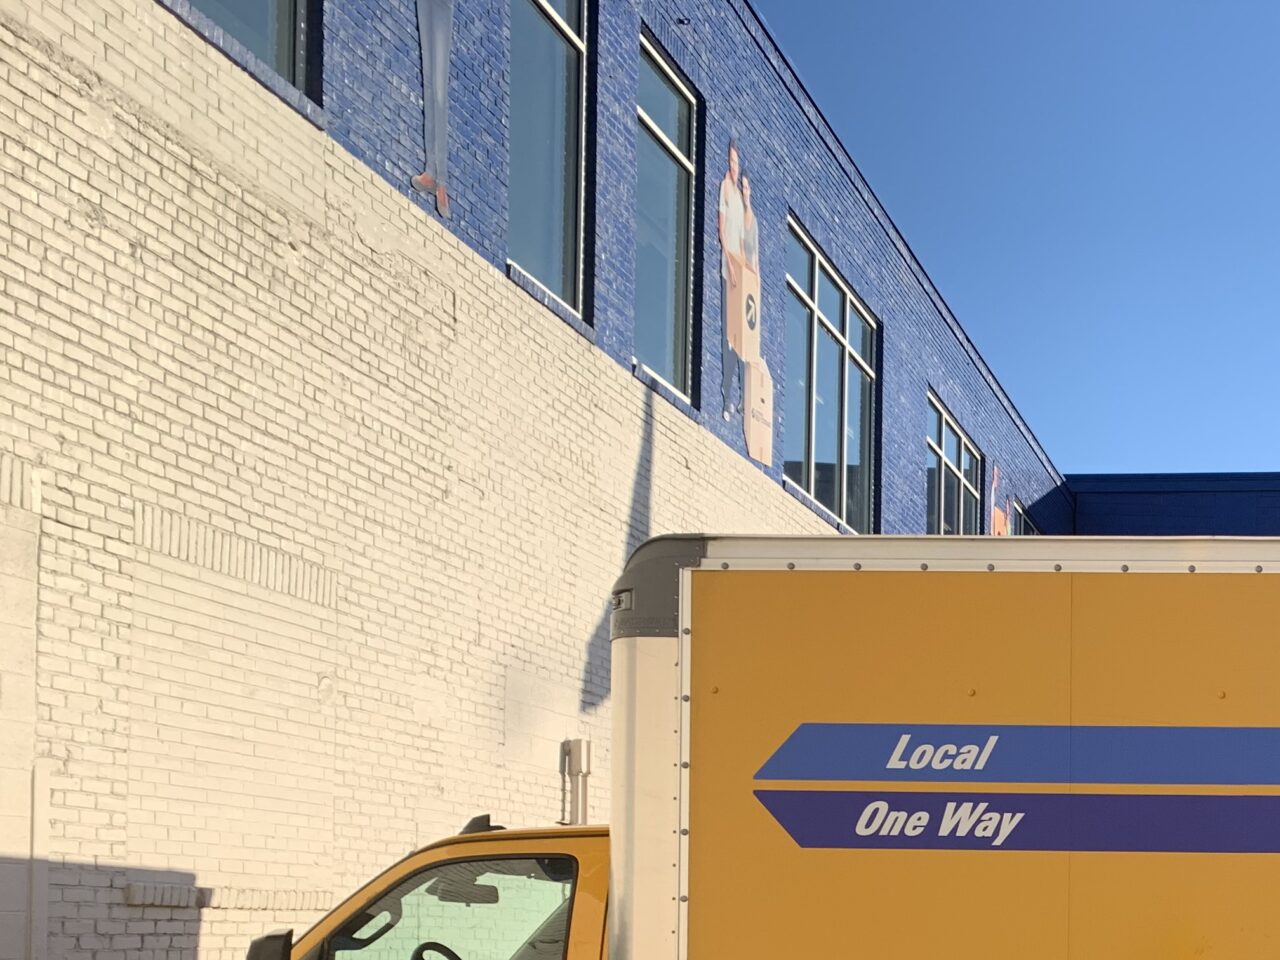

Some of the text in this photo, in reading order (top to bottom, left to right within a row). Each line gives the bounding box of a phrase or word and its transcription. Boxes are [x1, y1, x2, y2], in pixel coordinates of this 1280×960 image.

[886, 733, 1000, 771] Local
[855, 800, 1026, 846] One Way
